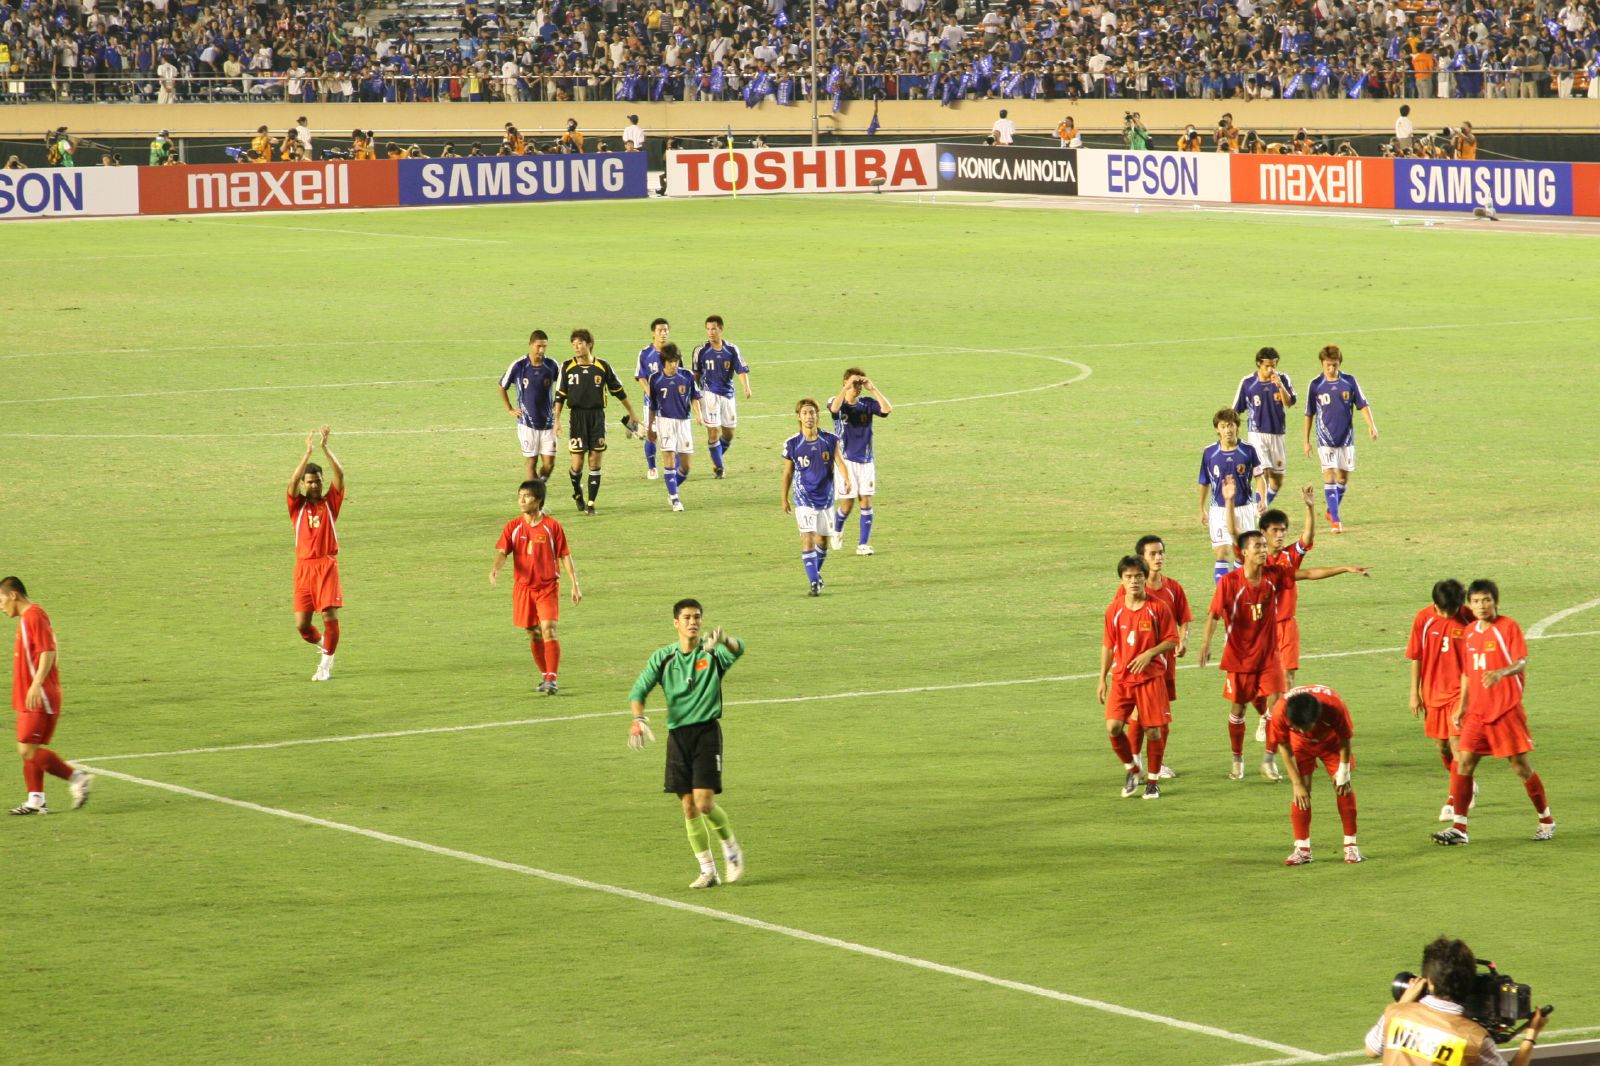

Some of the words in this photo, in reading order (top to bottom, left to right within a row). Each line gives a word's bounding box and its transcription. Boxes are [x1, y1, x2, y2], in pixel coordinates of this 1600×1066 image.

[676, 148, 927, 191] TOSHIBA
[957, 157, 1012, 180] KONICA
[1013, 159, 1076, 182] MINOLTA
[1107, 154, 1198, 196] EPSON
[187, 163, 349, 208] maxell
[422, 158, 624, 199] SAMSUNG
[1260, 160, 1363, 204] maxell
[1410, 164, 1556, 207] SAMSUNG
[648, 361, 659, 372] 14
[705, 359, 715, 371] 11
[522, 378, 529, 389] 9
[567, 373, 579, 385] 21
[660, 387, 668, 399] 7
[1253, 395, 1261, 406] 8
[1318, 393, 1331, 406] 10
[571, 437, 583, 449] 21
[797, 455, 810, 468] 16
[1213, 464, 1220, 478] 4
[1126, 630, 1135, 647] 4
[1441, 636, 1449, 652] 3
[1473, 653, 1486, 670] 14
